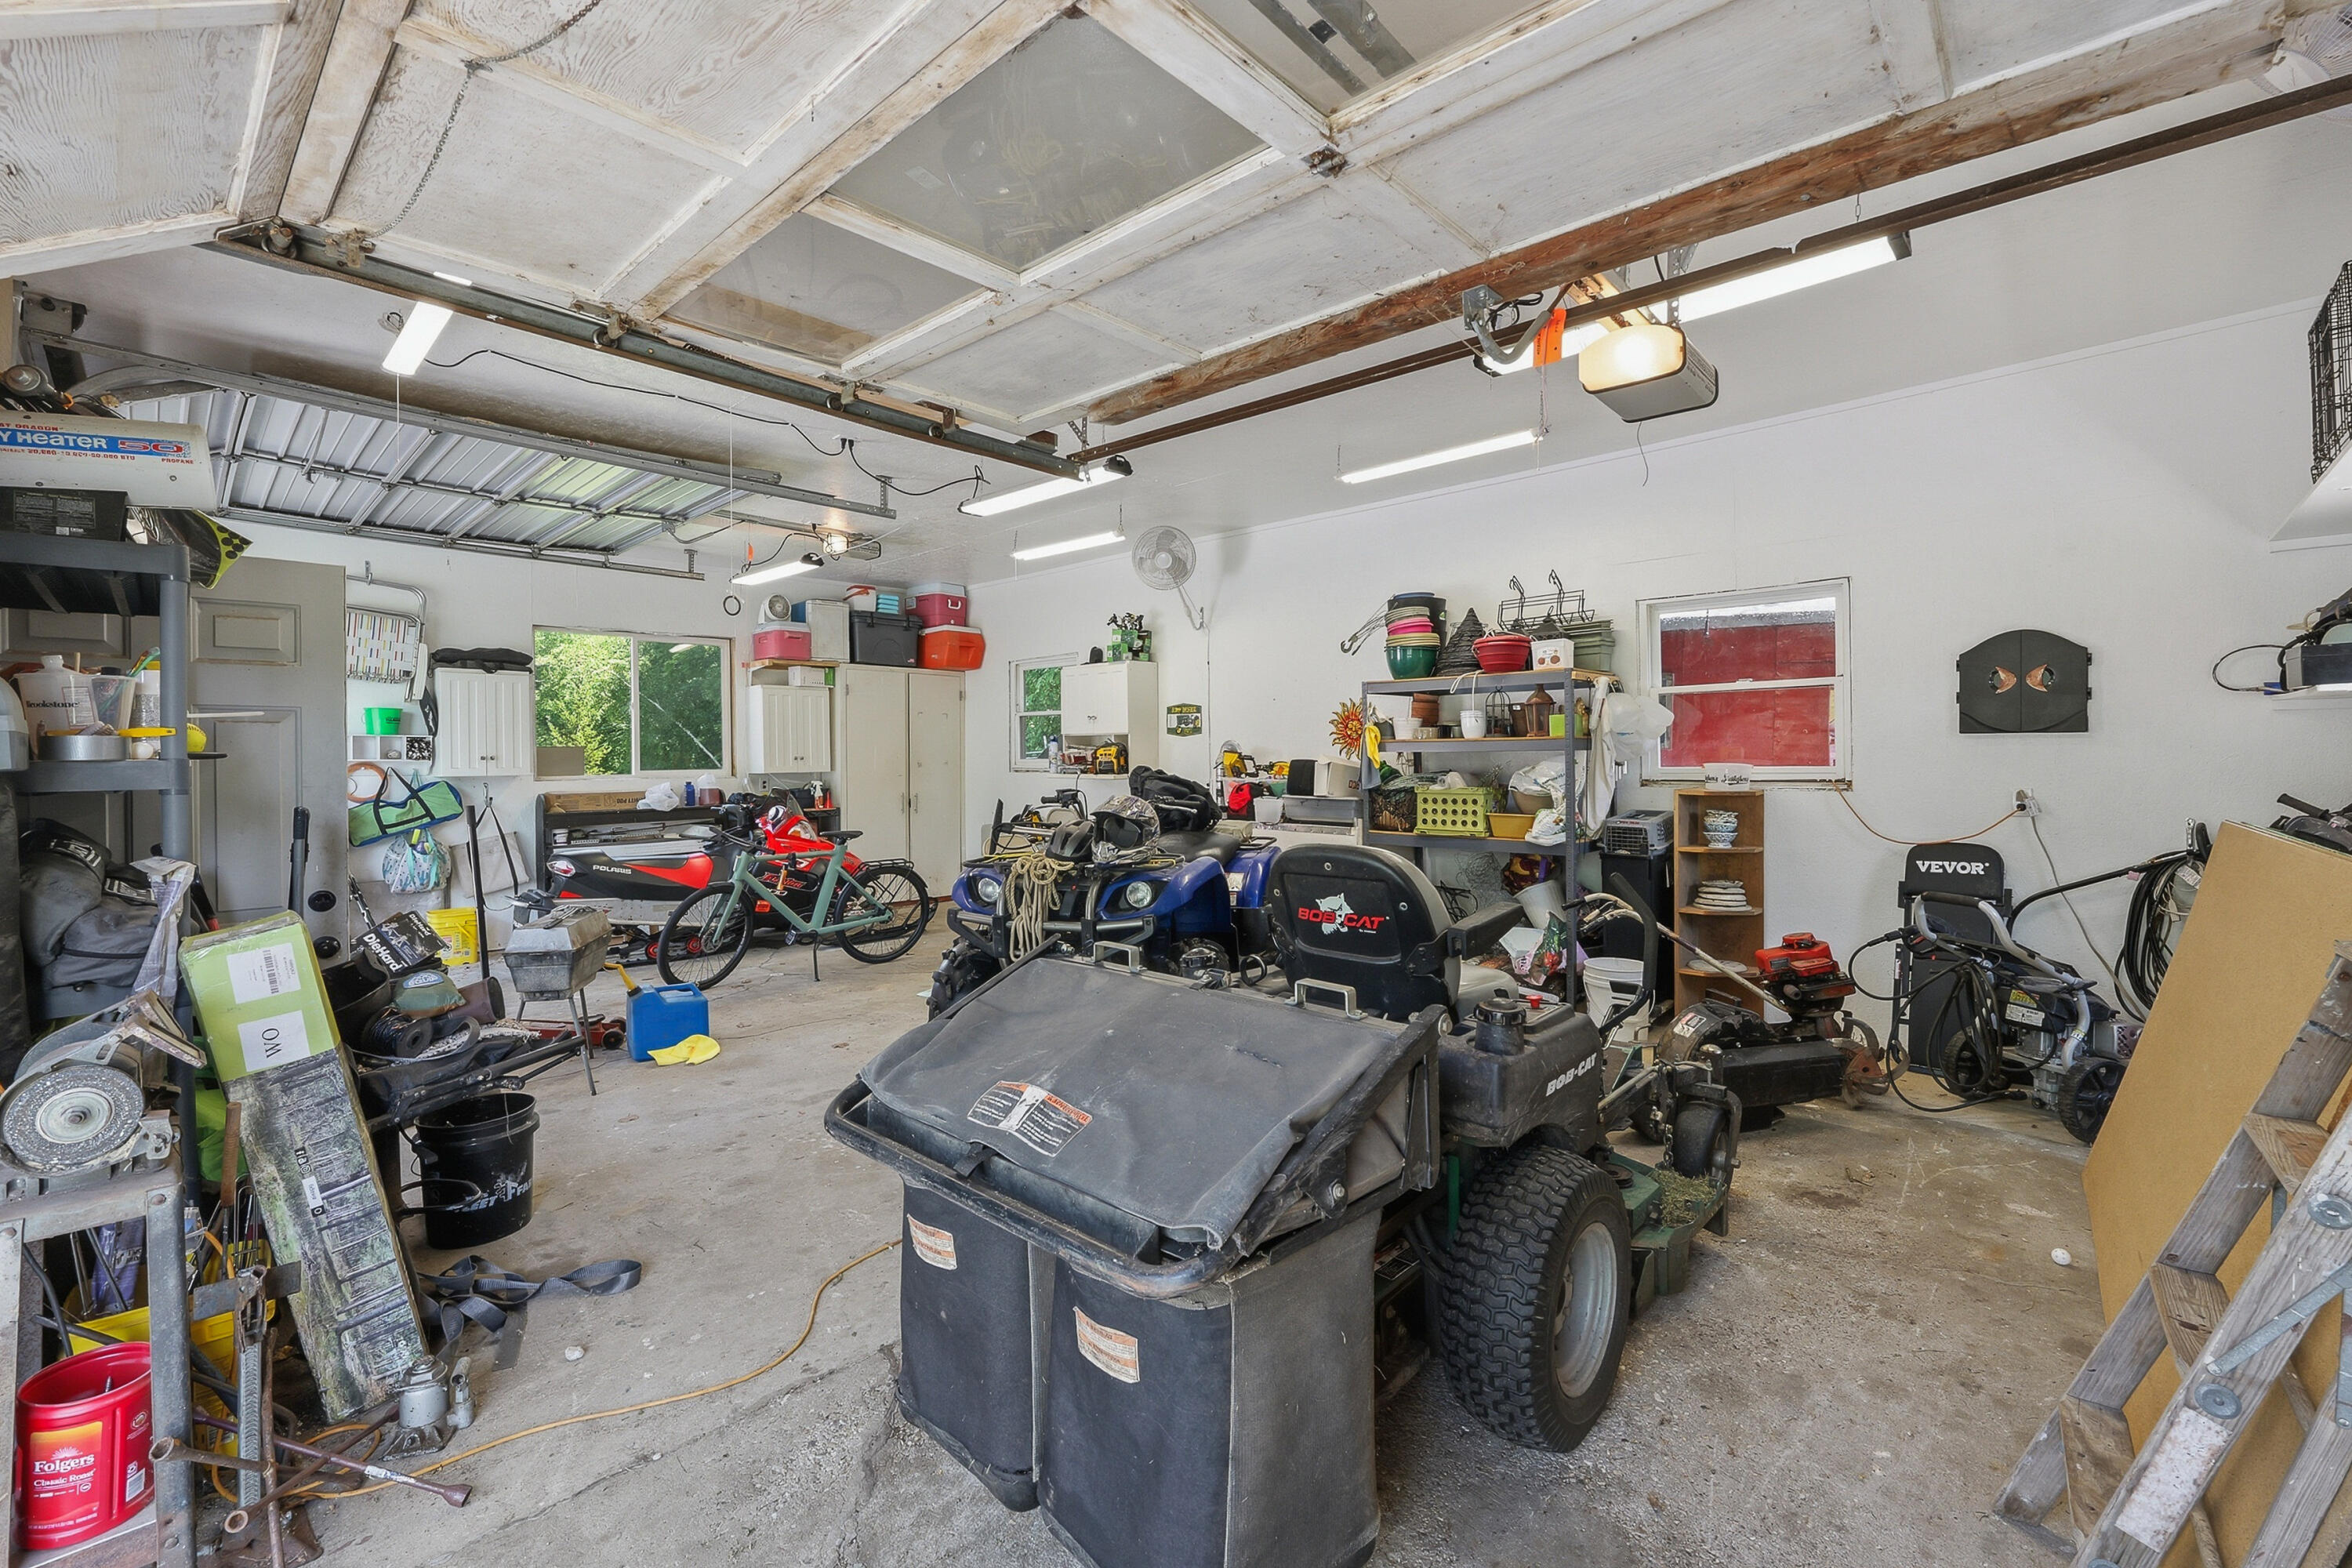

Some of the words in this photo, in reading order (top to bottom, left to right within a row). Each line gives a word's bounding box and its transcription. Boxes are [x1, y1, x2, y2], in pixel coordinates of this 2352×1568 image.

[118, 440, 184, 453] 50
[593, 865, 632, 875] POLARIS
[1915, 860, 1986, 875] VEVOR
[362, 933, 403, 973] DieHard
[261, 1028, 282, 1059] WO
[1545, 1052, 1597, 1097] BOB-CAT
[34, 1454, 95, 1473] Folgers
[34, 1477, 67, 1486] Classic
[68, 1469, 96, 1483] Roast
